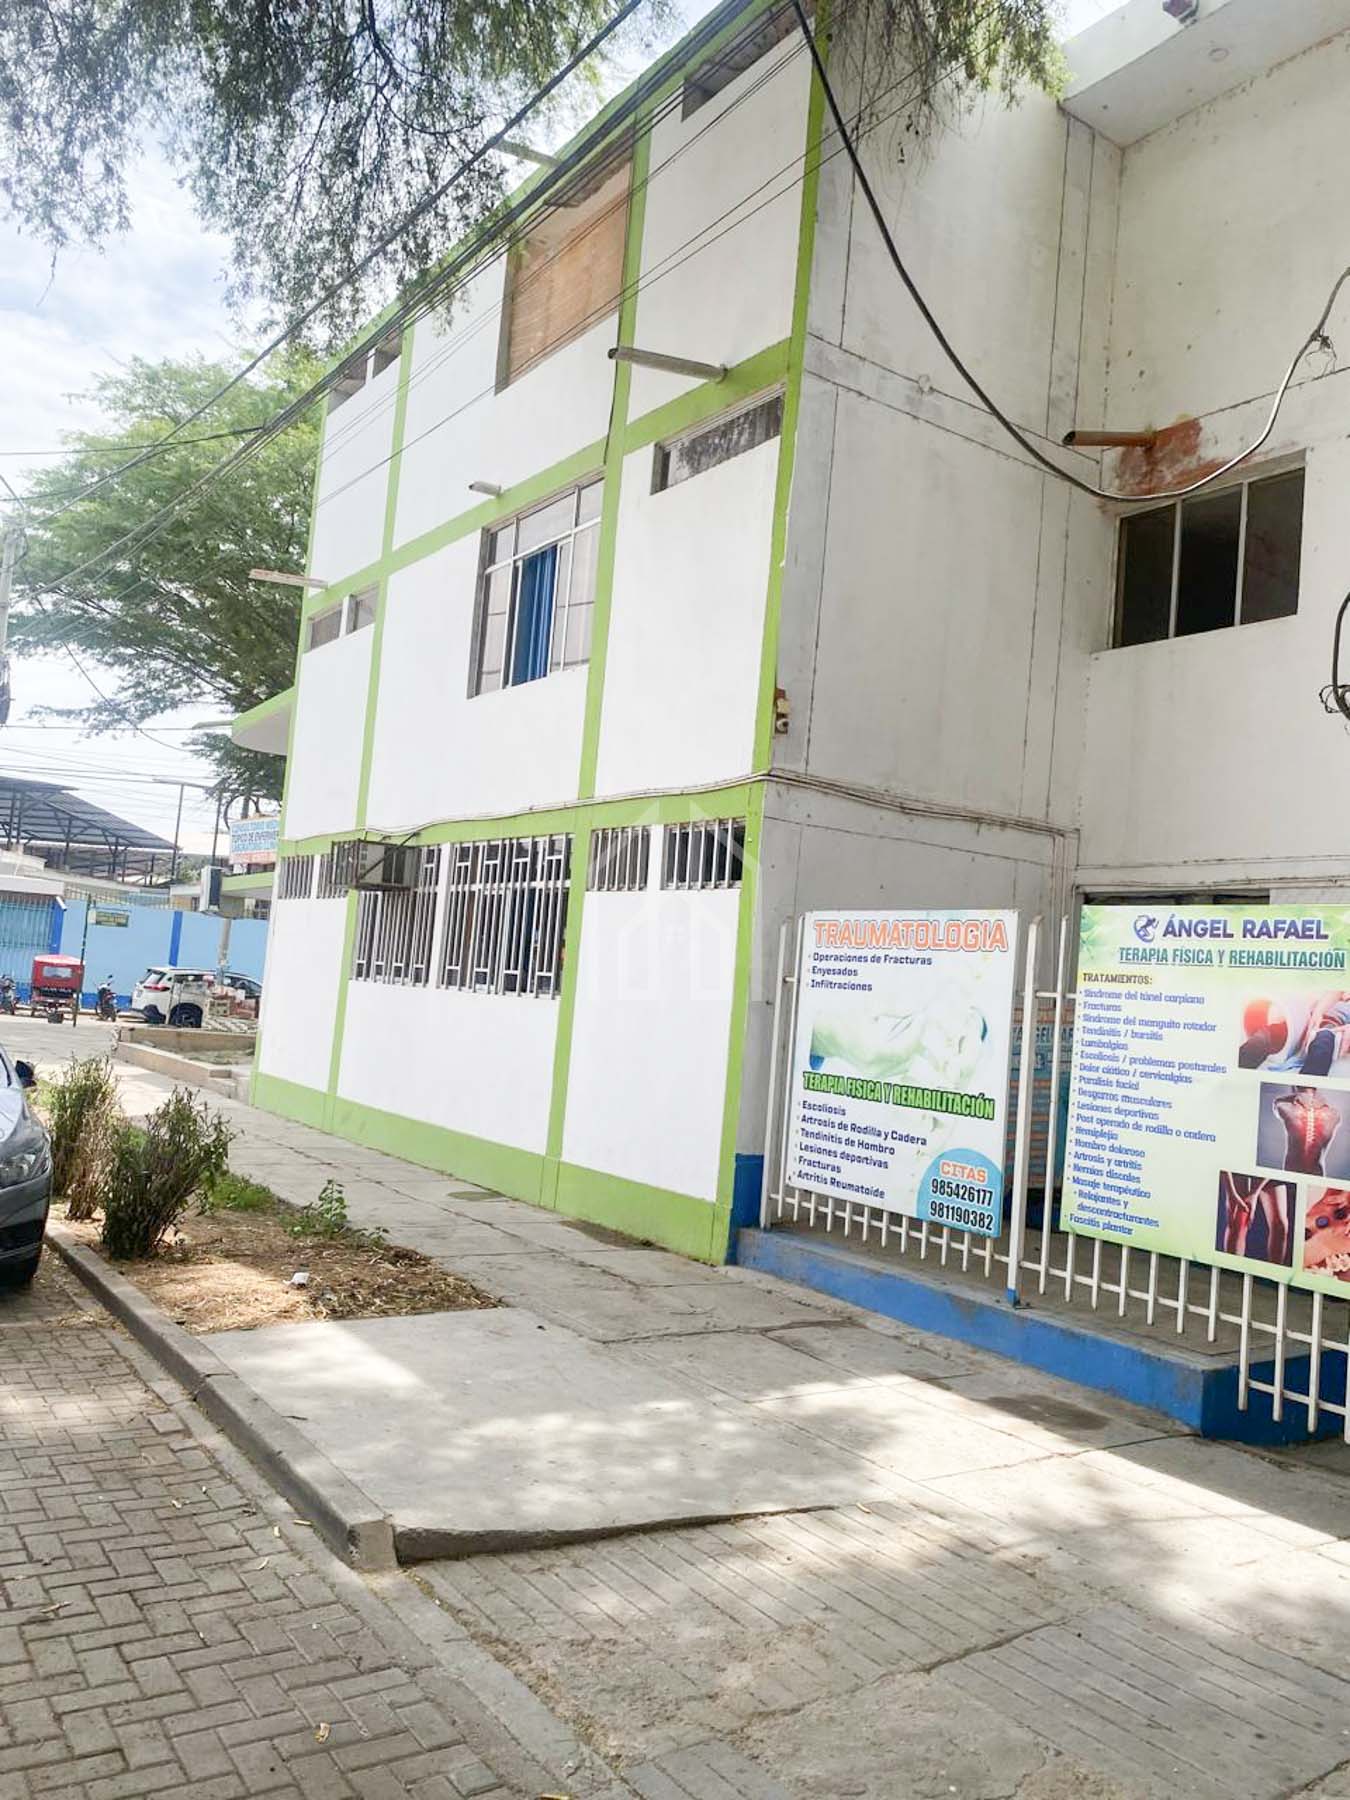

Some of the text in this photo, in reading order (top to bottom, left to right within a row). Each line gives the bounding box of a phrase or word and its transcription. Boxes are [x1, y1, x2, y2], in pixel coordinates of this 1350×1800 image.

[814, 920, 1009, 952] TRAUMATOLOGIA
[1163, 913, 1329, 940] ÁNGEL RAFAEL
[813, 952, 932, 966] Operaciones de Fracturas
[1119, 947, 1168, 963] TERAPIA
[812, 965, 858, 977] Enyesados
[1083, 973, 1152, 985] TRATAMIENTOS:
[810, 979, 873, 992] Infiltraciones
[1124, 990, 1138, 1000] del
[1083, 1002, 1122, 1012] Fracturas
[1123, 1016, 1136, 1026] del
[1138, 1018, 1180, 1030] manguito
[1183, 1021, 1216, 1032] rotador
[1079, 1063, 1100, 1072] Dolor
[1129, 1055, 1176, 1068] problemas
[1178, 1062, 1227, 1074] posturales
[803, 1071, 845, 1095] TERAPIA
[846, 1077, 882, 1103] FISICA
[892, 1084, 995, 1120] REHABILITACIÓN
[1121, 1095, 1172, 1108] musculares
[802, 1100, 846, 1116] Escoliosis
[1077, 1101, 1159, 1120] Lesiones deportivas
[801, 1115, 836, 1128] Artrosis
[837, 1122, 849, 1131] de
[850, 1123, 882, 1137] Rodilla
[891, 1130, 927, 1146] Cadera
[1076, 1113, 1093, 1124] Post
[1096, 1117, 1130, 1129] operado
[1131, 1121, 1143, 1131] de
[1145, 1124, 1173, 1135] rodilla
[1183, 1130, 1216, 1142] cadera
[800, 1128, 895, 1155] Tendinitis de Hombro
[798, 1155, 841, 1173] Fracturas
[799, 1142, 889, 1169] Lesiones deportivas
[941, 1160, 987, 1184] CITAS
[797, 1170, 885, 1199] Artritis Reumatoide
[931, 1178, 993, 1206] 985426177
[930, 1201, 994, 1231] 981190382
